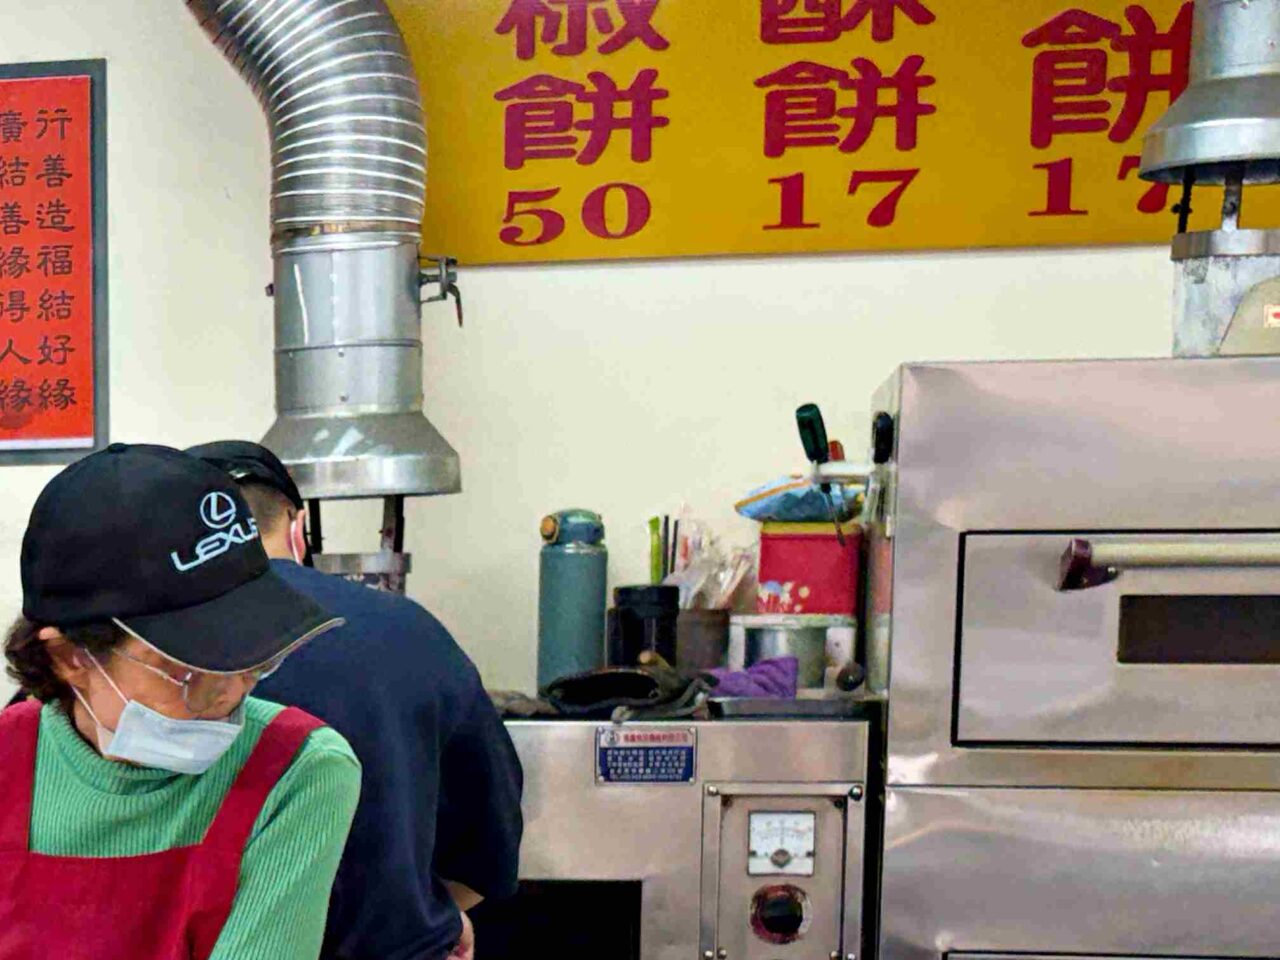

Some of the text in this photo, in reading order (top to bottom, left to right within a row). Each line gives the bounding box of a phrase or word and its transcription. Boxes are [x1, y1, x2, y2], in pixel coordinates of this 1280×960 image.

[499, 183, 652, 247] 50
[762, 168, 921, 231] 17
[34, 108, 78, 411] 行善造福結好緣
